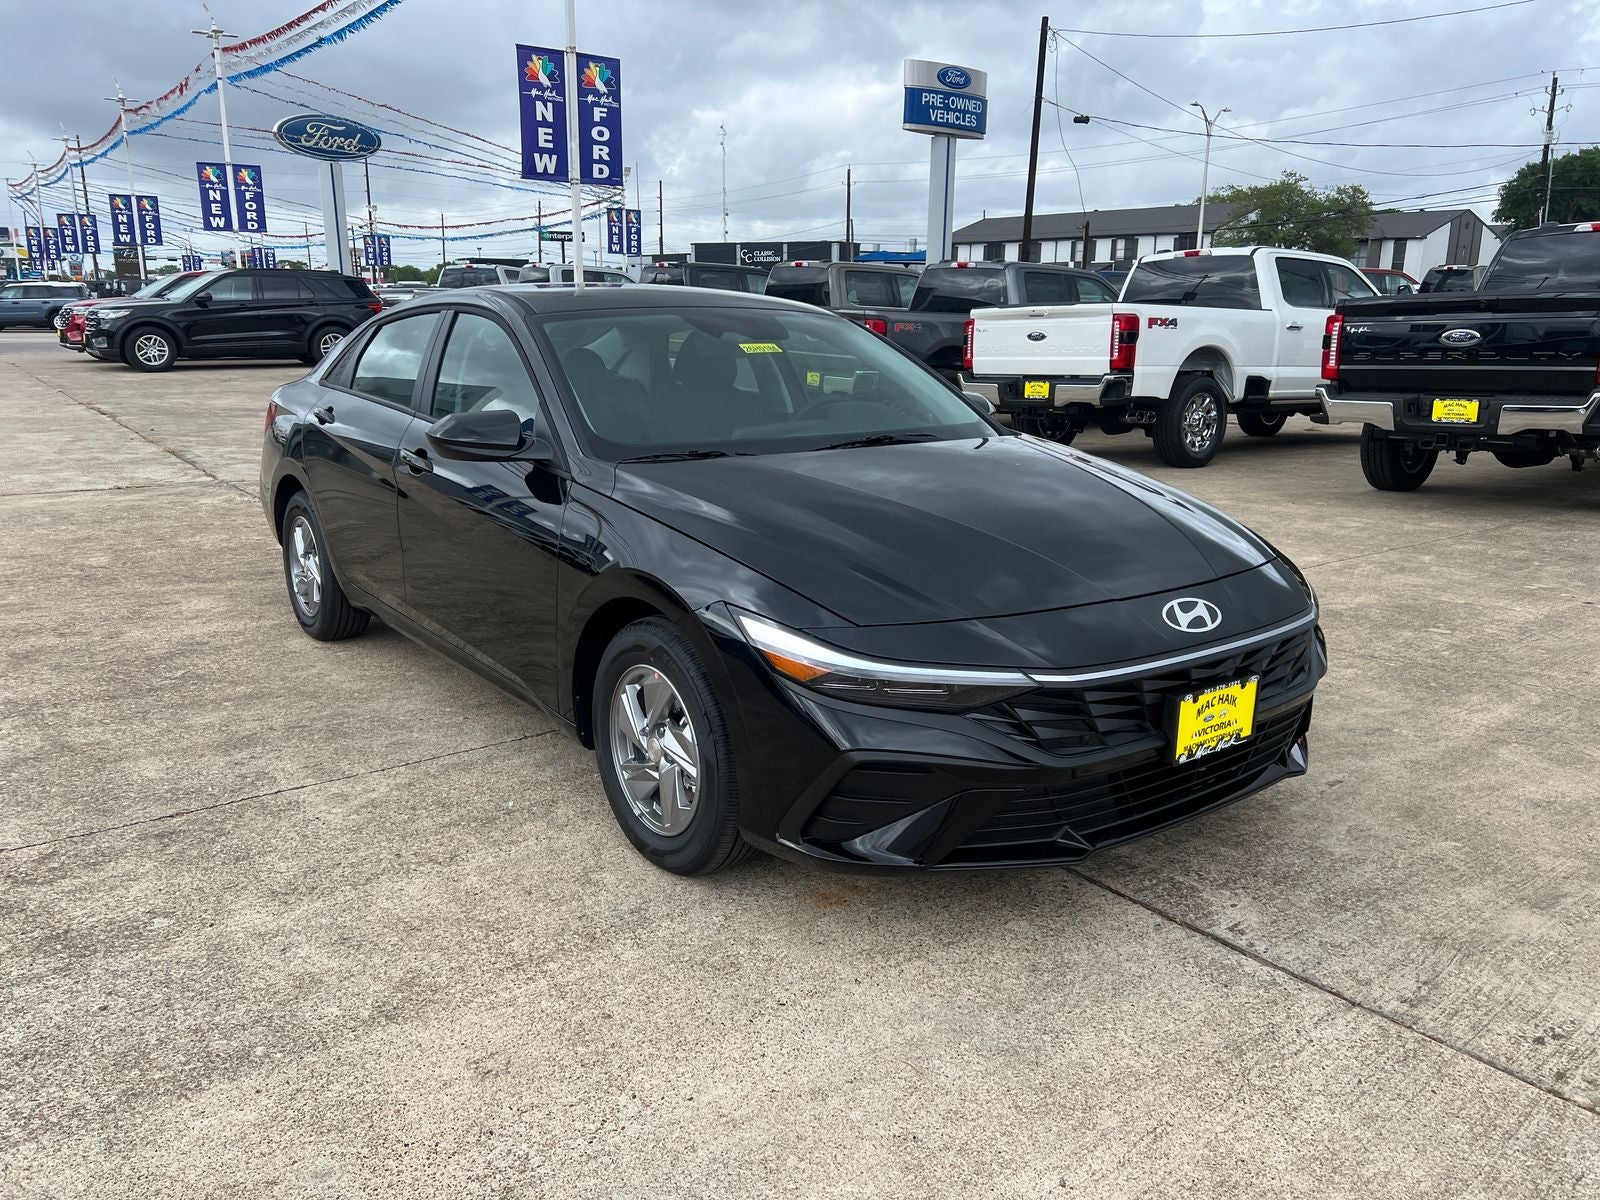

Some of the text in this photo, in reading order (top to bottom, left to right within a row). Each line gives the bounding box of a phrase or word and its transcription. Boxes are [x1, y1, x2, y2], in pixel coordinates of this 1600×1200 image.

[945, 70, 966, 84] Ford
[922, 93, 983, 113] PRE-OWNED
[930, 109, 977, 127] VEHICLES
[300, 122, 361, 151] Ford
[533, 101, 557, 175] NEW
[591, 107, 611, 179] FORD
[208, 190, 225, 228] NEW
[245, 192, 259, 230] FORD
[64, 229, 75, 252] NEW
[118, 215, 131, 243] NEW
[145, 215, 156, 244] FORD
[611, 226, 620, 252] NEW
[630, 227, 638, 253] FORD
[31, 240, 40, 258] NEW
[49, 240, 57, 259] FORD
[86, 229, 96, 253] FORD
[367, 247, 375, 265] NEW
[894, 322, 921, 332] FX4
[1147, 317, 1178, 329] FX4
[1352, 351, 1582, 361] SUPER DUTY
[1196, 696, 1217, 720] MAC
[1217, 693, 1238, 708] HAIK
[1197, 719, 1232, 737] VICTORIA
